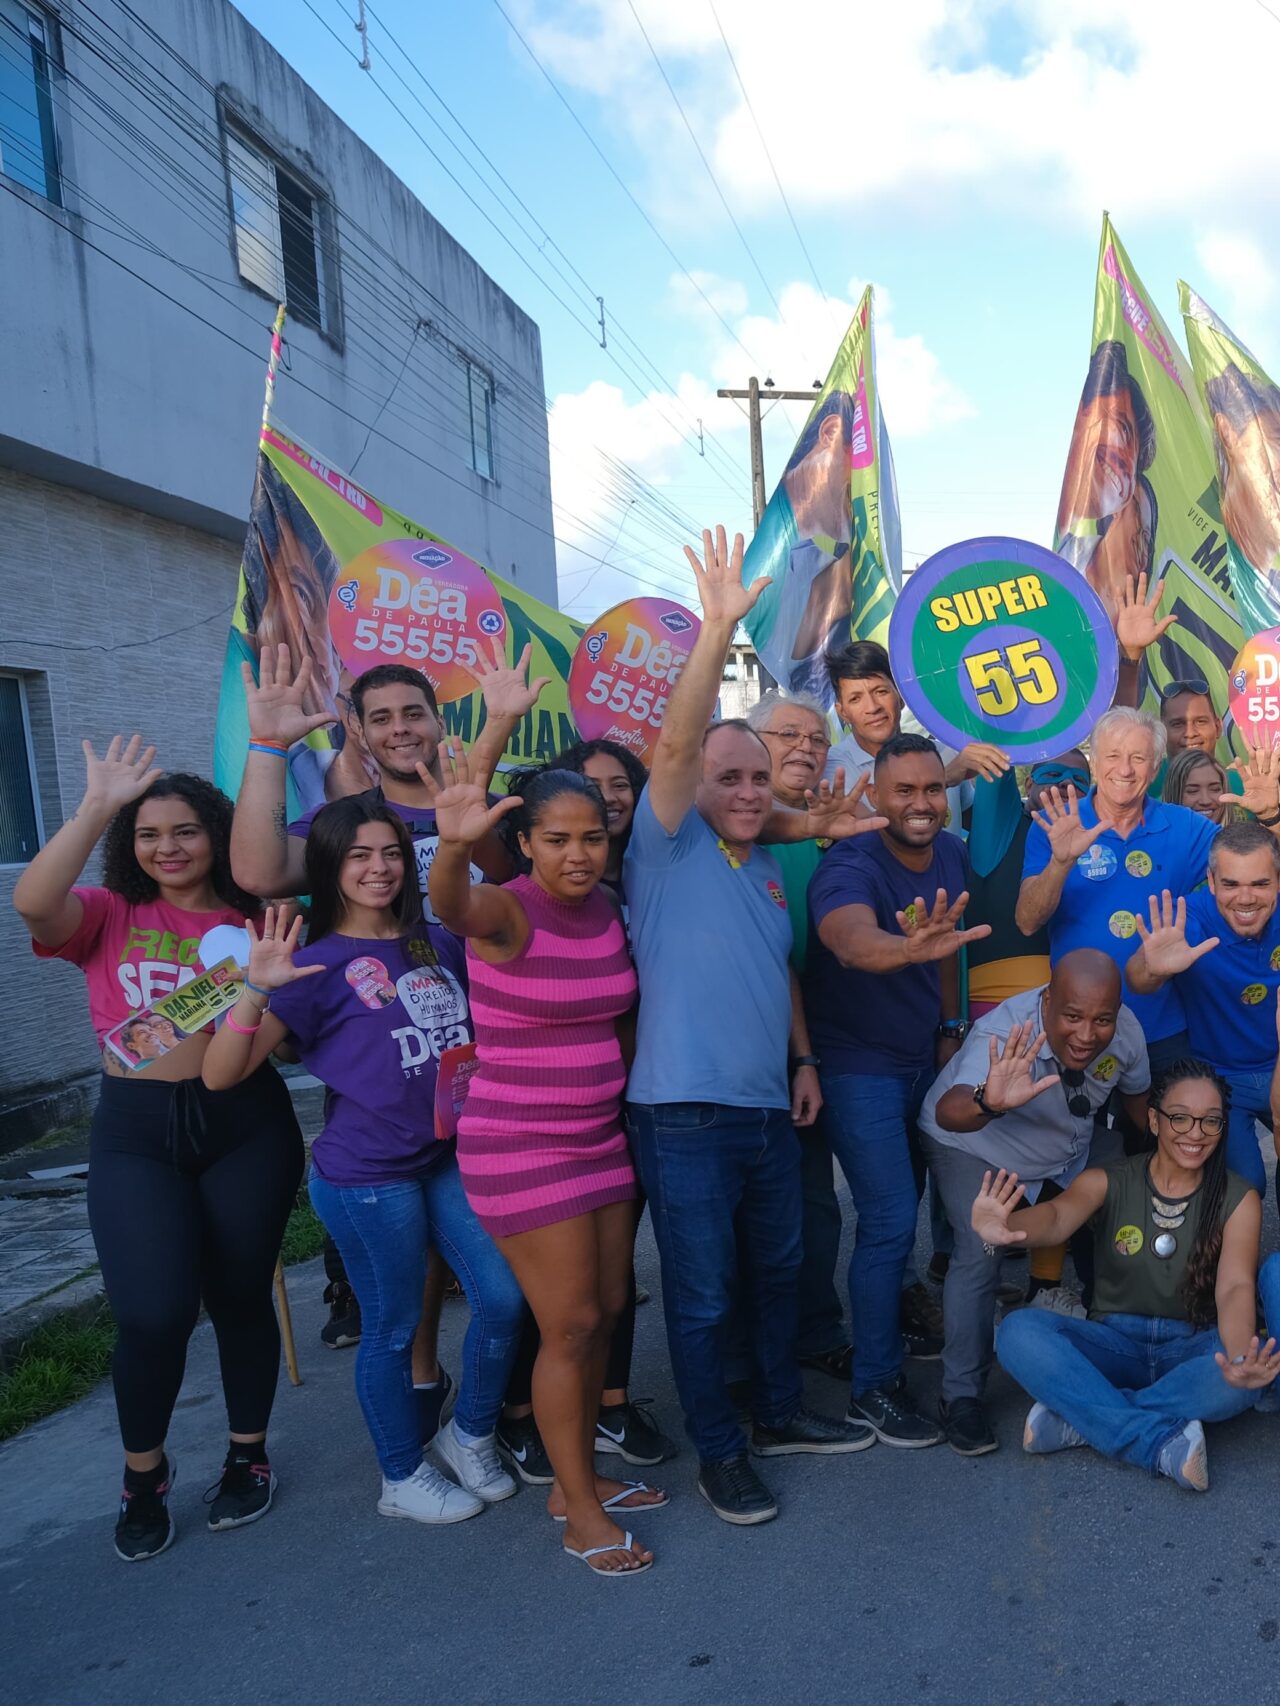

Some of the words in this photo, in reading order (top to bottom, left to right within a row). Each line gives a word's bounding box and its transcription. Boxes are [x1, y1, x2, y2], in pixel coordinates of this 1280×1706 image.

[1187, 507, 1208, 532] VICE
[372, 567, 468, 623] Déa
[930, 574, 1048, 633] SUPER
[372, 608, 393, 620] DE
[408, 614, 466, 633] PAULA
[353, 618, 478, 667] 55555
[610, 663, 630, 677] DE
[640, 675, 668, 692] PAU
[963, 638, 1059, 717] 55
[585, 671, 668, 728] 5555
[120, 927, 201, 965] REC
[163, 979, 216, 1019] DANIEL
[179, 1000, 208, 1022] MARIANA
[204, 982, 242, 1009] 55
[410, 986, 458, 1004] DIREITOS
[420, 999, 458, 1015] HUMANOS
